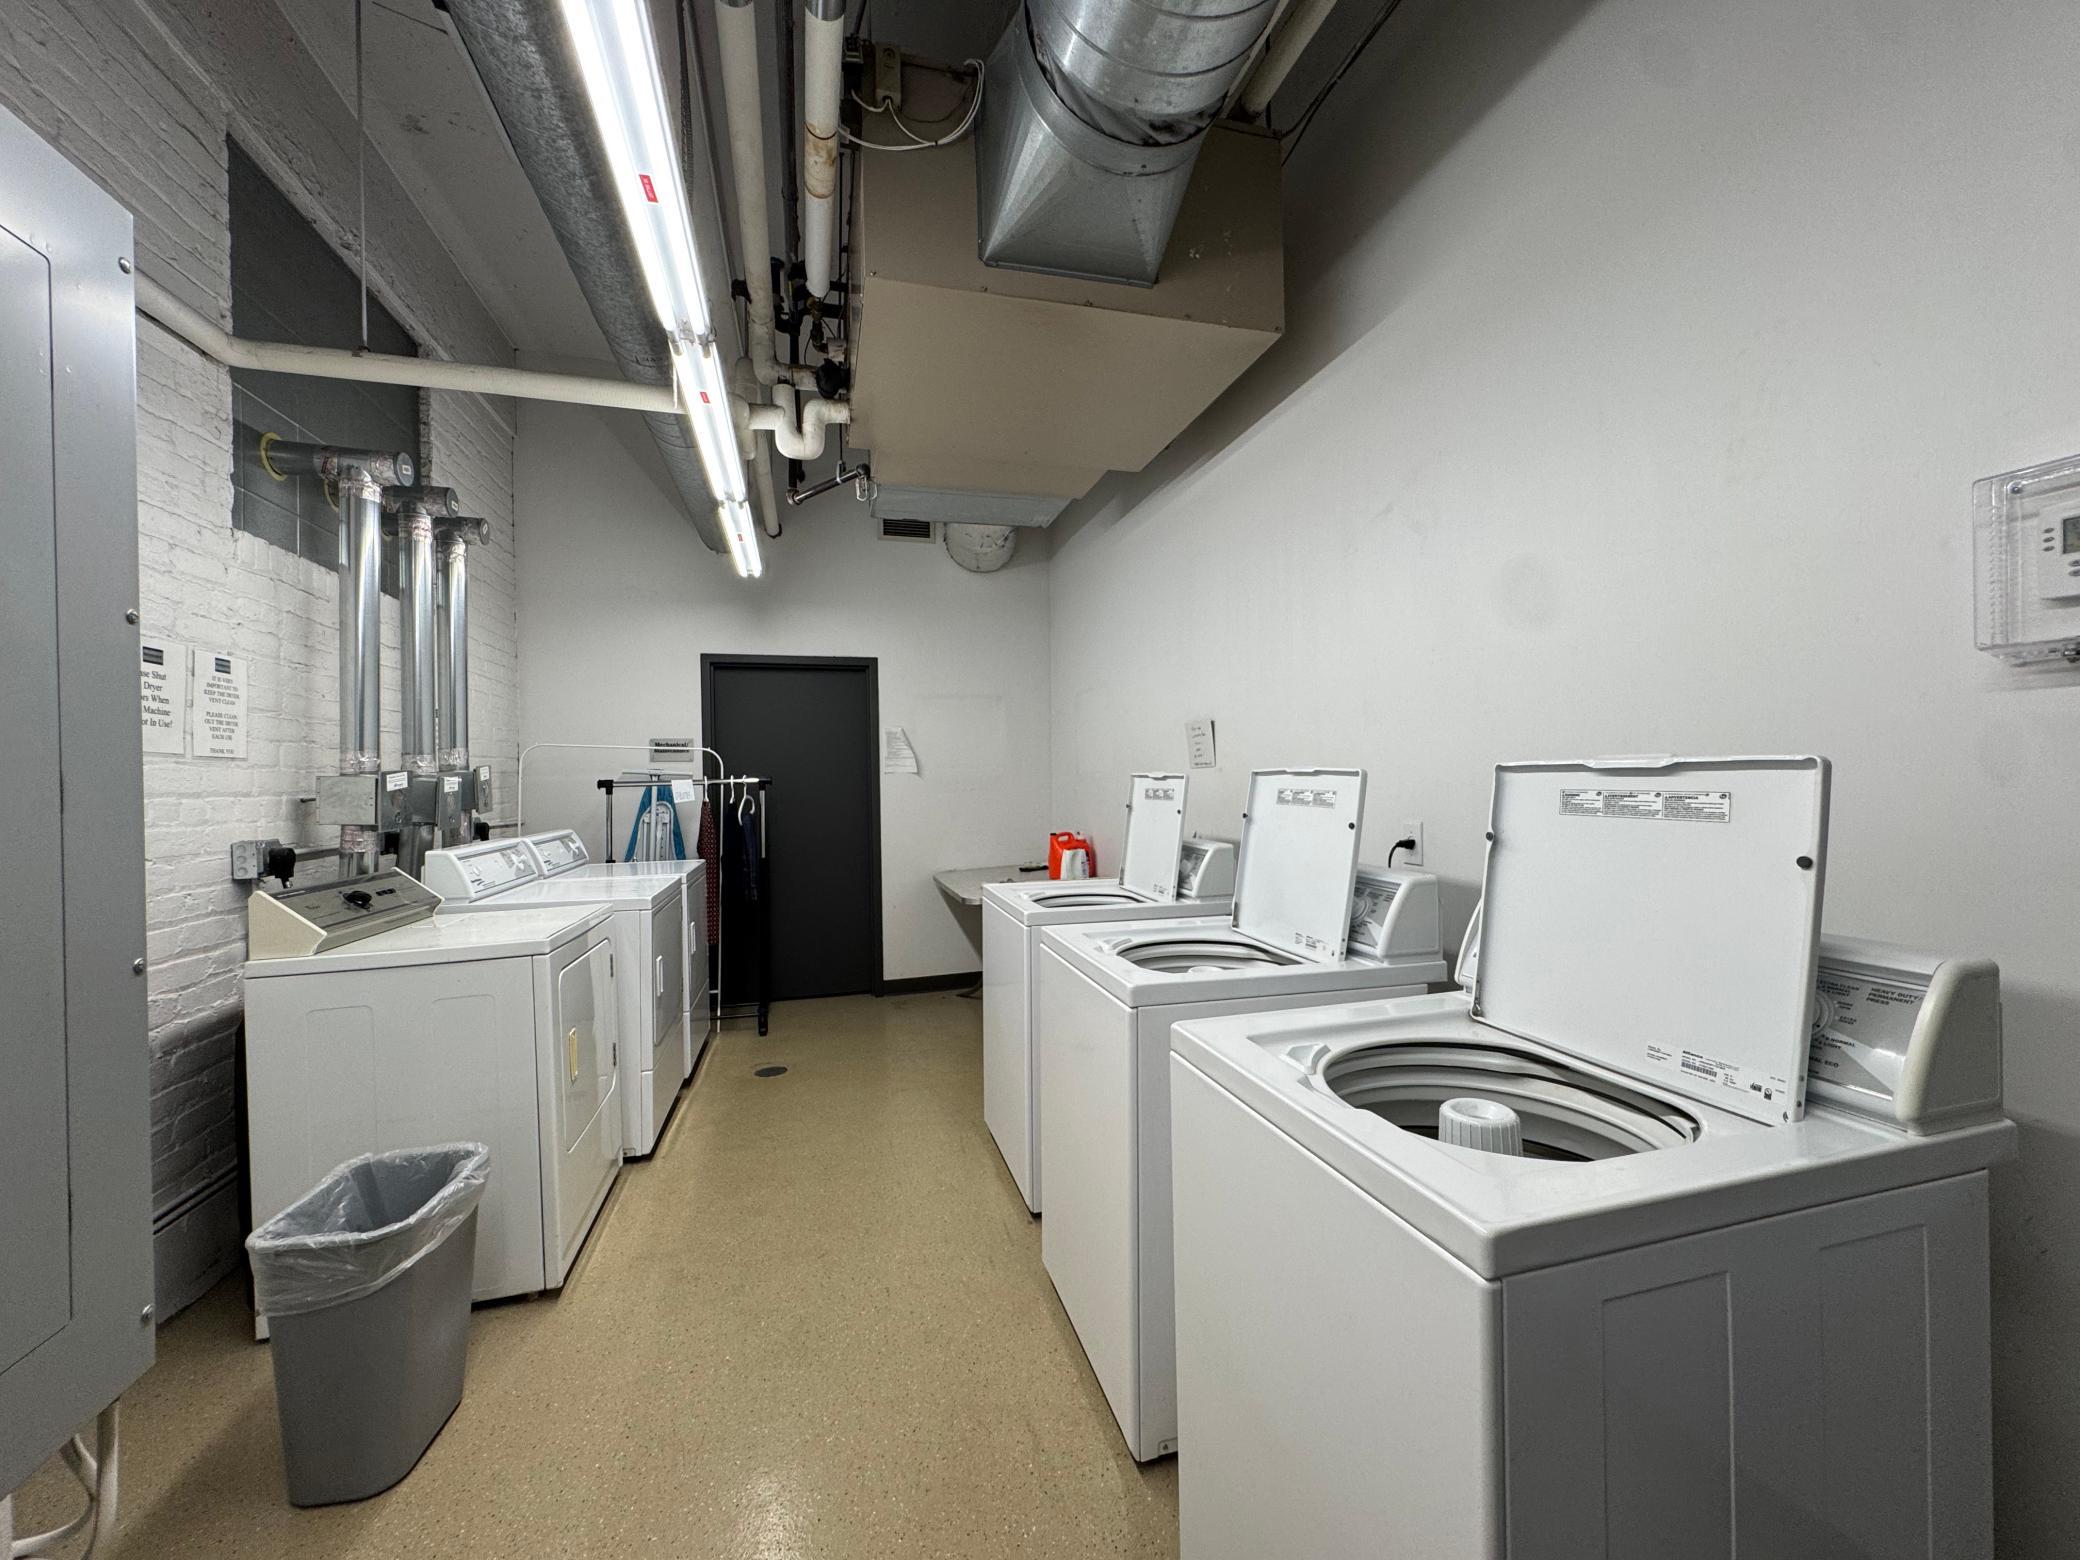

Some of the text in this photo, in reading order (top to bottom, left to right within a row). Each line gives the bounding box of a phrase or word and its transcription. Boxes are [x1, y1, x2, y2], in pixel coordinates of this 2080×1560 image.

[151, 671, 166, 680] Shut
[144, 681, 163, 692] Dryer
[151, 694, 169, 704] When
[143, 705, 171, 717] Machine
[150, 718, 157, 726] In
[158, 719, 173, 728] Use!
[1868, 992, 1915, 1005] PERMANENT
[1872, 987, 1923, 1001] HEAVY DUTY/
[1866, 997, 1890, 1006] PRESS
[1830, 1037, 1855, 1047] NORMAL
[1824, 1060, 1839, 1069] ECO
